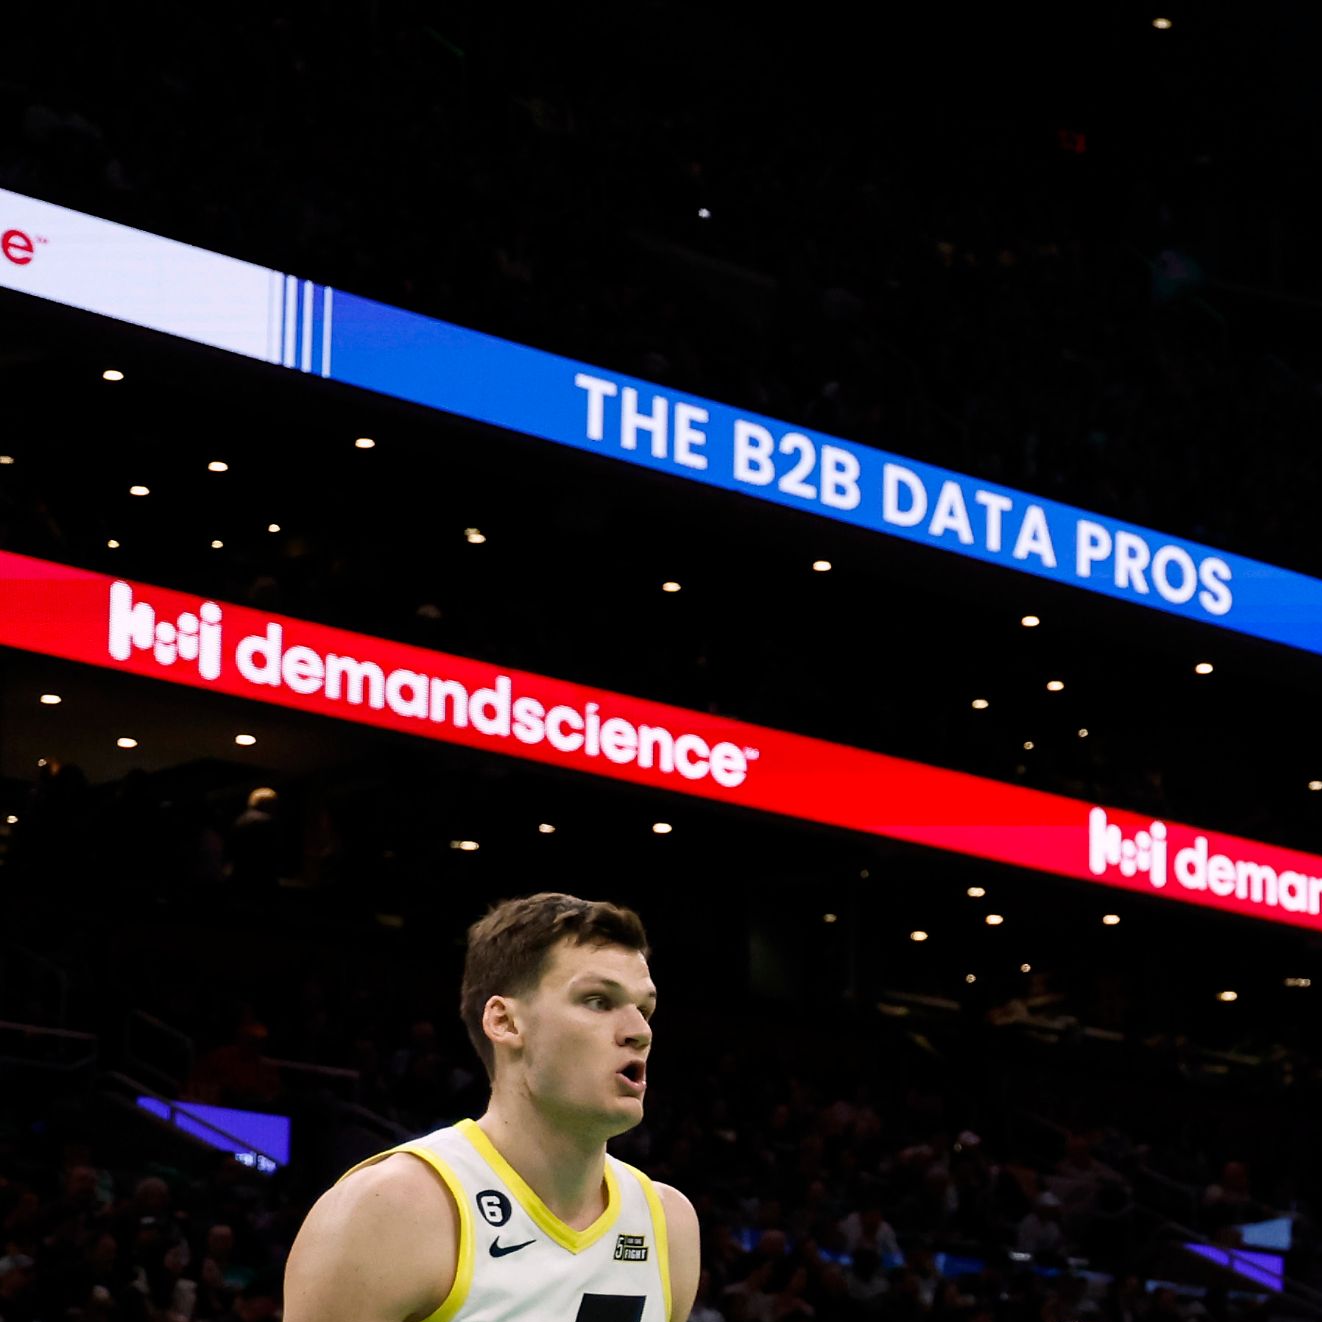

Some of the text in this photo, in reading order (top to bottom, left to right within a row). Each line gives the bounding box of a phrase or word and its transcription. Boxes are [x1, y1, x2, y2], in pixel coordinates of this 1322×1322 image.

[575, 372, 1233, 616] THE B2B DATA PROS
[236, 622, 750, 789] demandscience
[480, 1195, 504, 1223] 6
